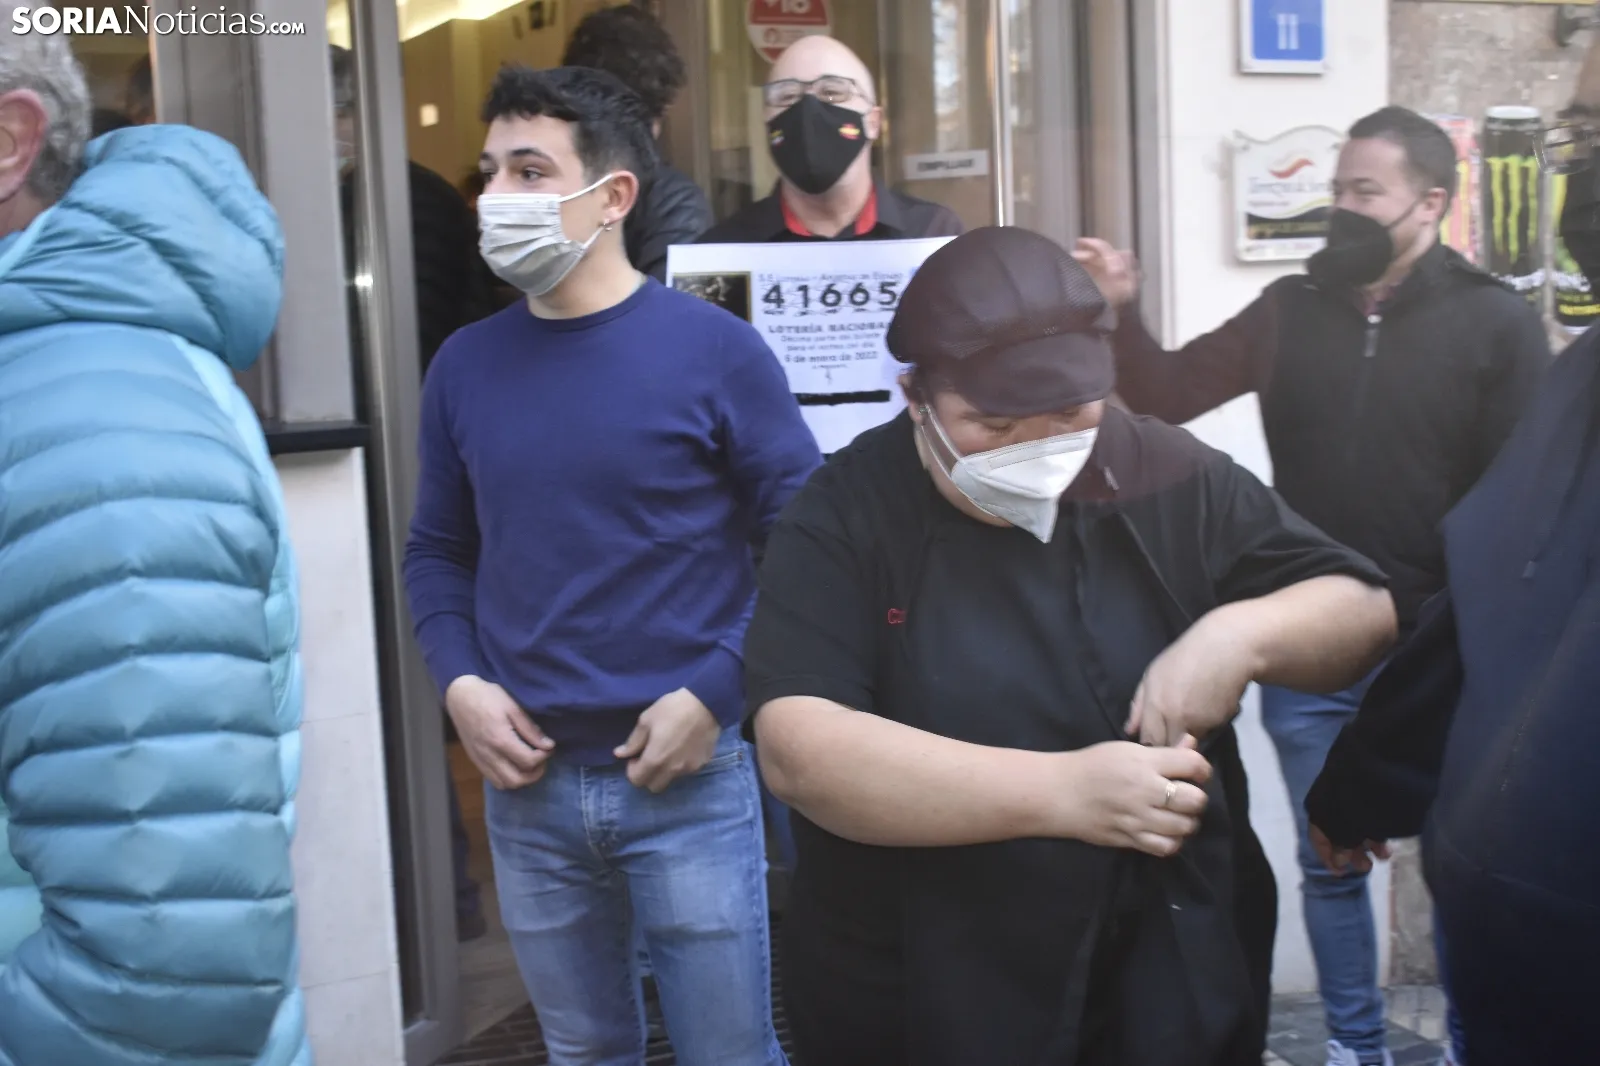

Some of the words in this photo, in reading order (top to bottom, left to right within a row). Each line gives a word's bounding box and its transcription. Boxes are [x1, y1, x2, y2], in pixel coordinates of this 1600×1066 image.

[762, 281, 898, 308] 41665
[828, 321, 889, 332] NACIONA
[793, 354, 806, 363] de
[809, 354, 837, 362] enero
[839, 352, 852, 361] de
